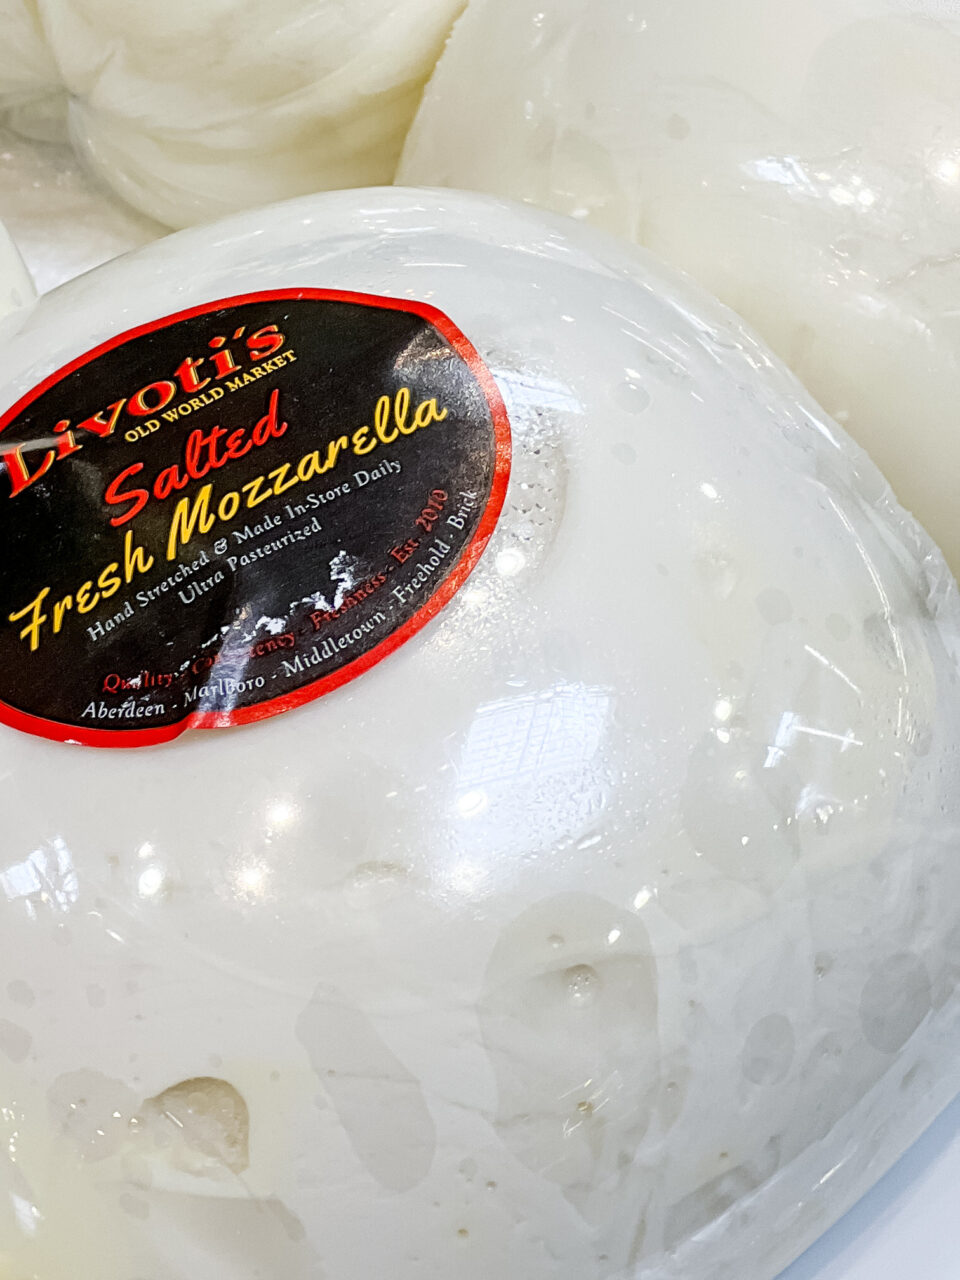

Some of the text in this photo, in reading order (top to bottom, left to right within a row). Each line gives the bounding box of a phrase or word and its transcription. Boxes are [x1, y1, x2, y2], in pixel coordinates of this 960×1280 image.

[2, 324, 286, 498] Livoti's
[104, 388, 288, 527] Salted
[124, 349, 297, 442] OLD WORLD MARKET
[8, 386, 449, 652] Fresh Mozzarella
[86, 459, 402, 642] Hand Stretched & Made In-Store Daily
[177, 517, 322, 605] Ultra Pasteurized
[415, 489, 448, 532] 2010
[81, 490, 478, 720] Aberdeen Marlboro Middletown Freehold Brick
